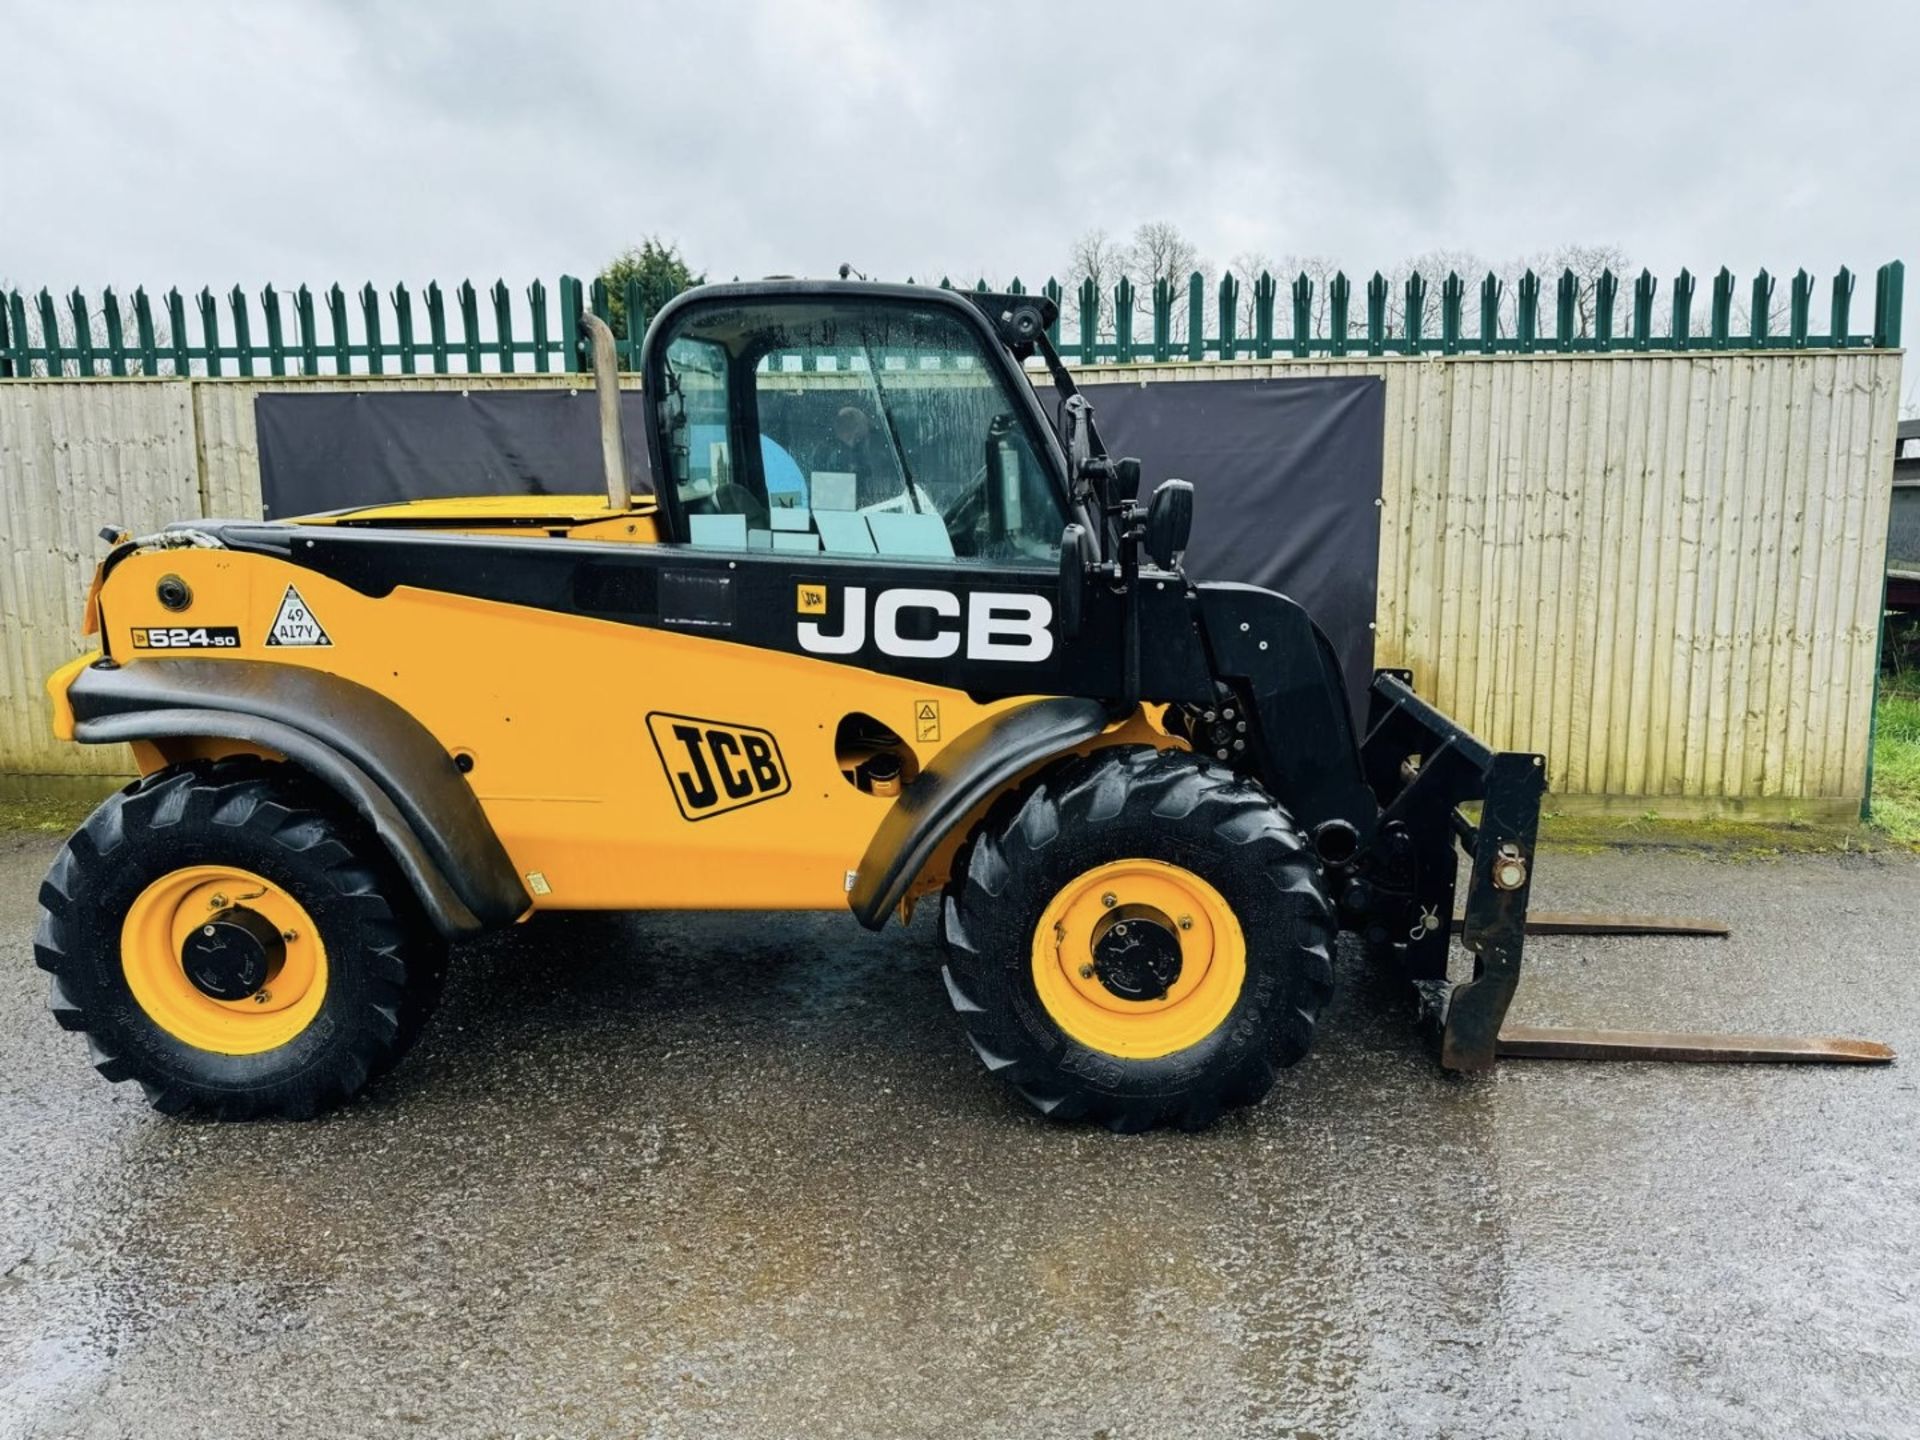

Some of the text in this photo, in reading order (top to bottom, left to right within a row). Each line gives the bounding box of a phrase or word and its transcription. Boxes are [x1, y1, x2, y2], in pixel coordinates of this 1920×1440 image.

[287, 608, 304, 622] 49
[797, 586, 1054, 663] JCB
[148, 628, 236, 647] 524-50
[280, 624, 313, 638] A17Y
[672, 724, 781, 809] JCB
